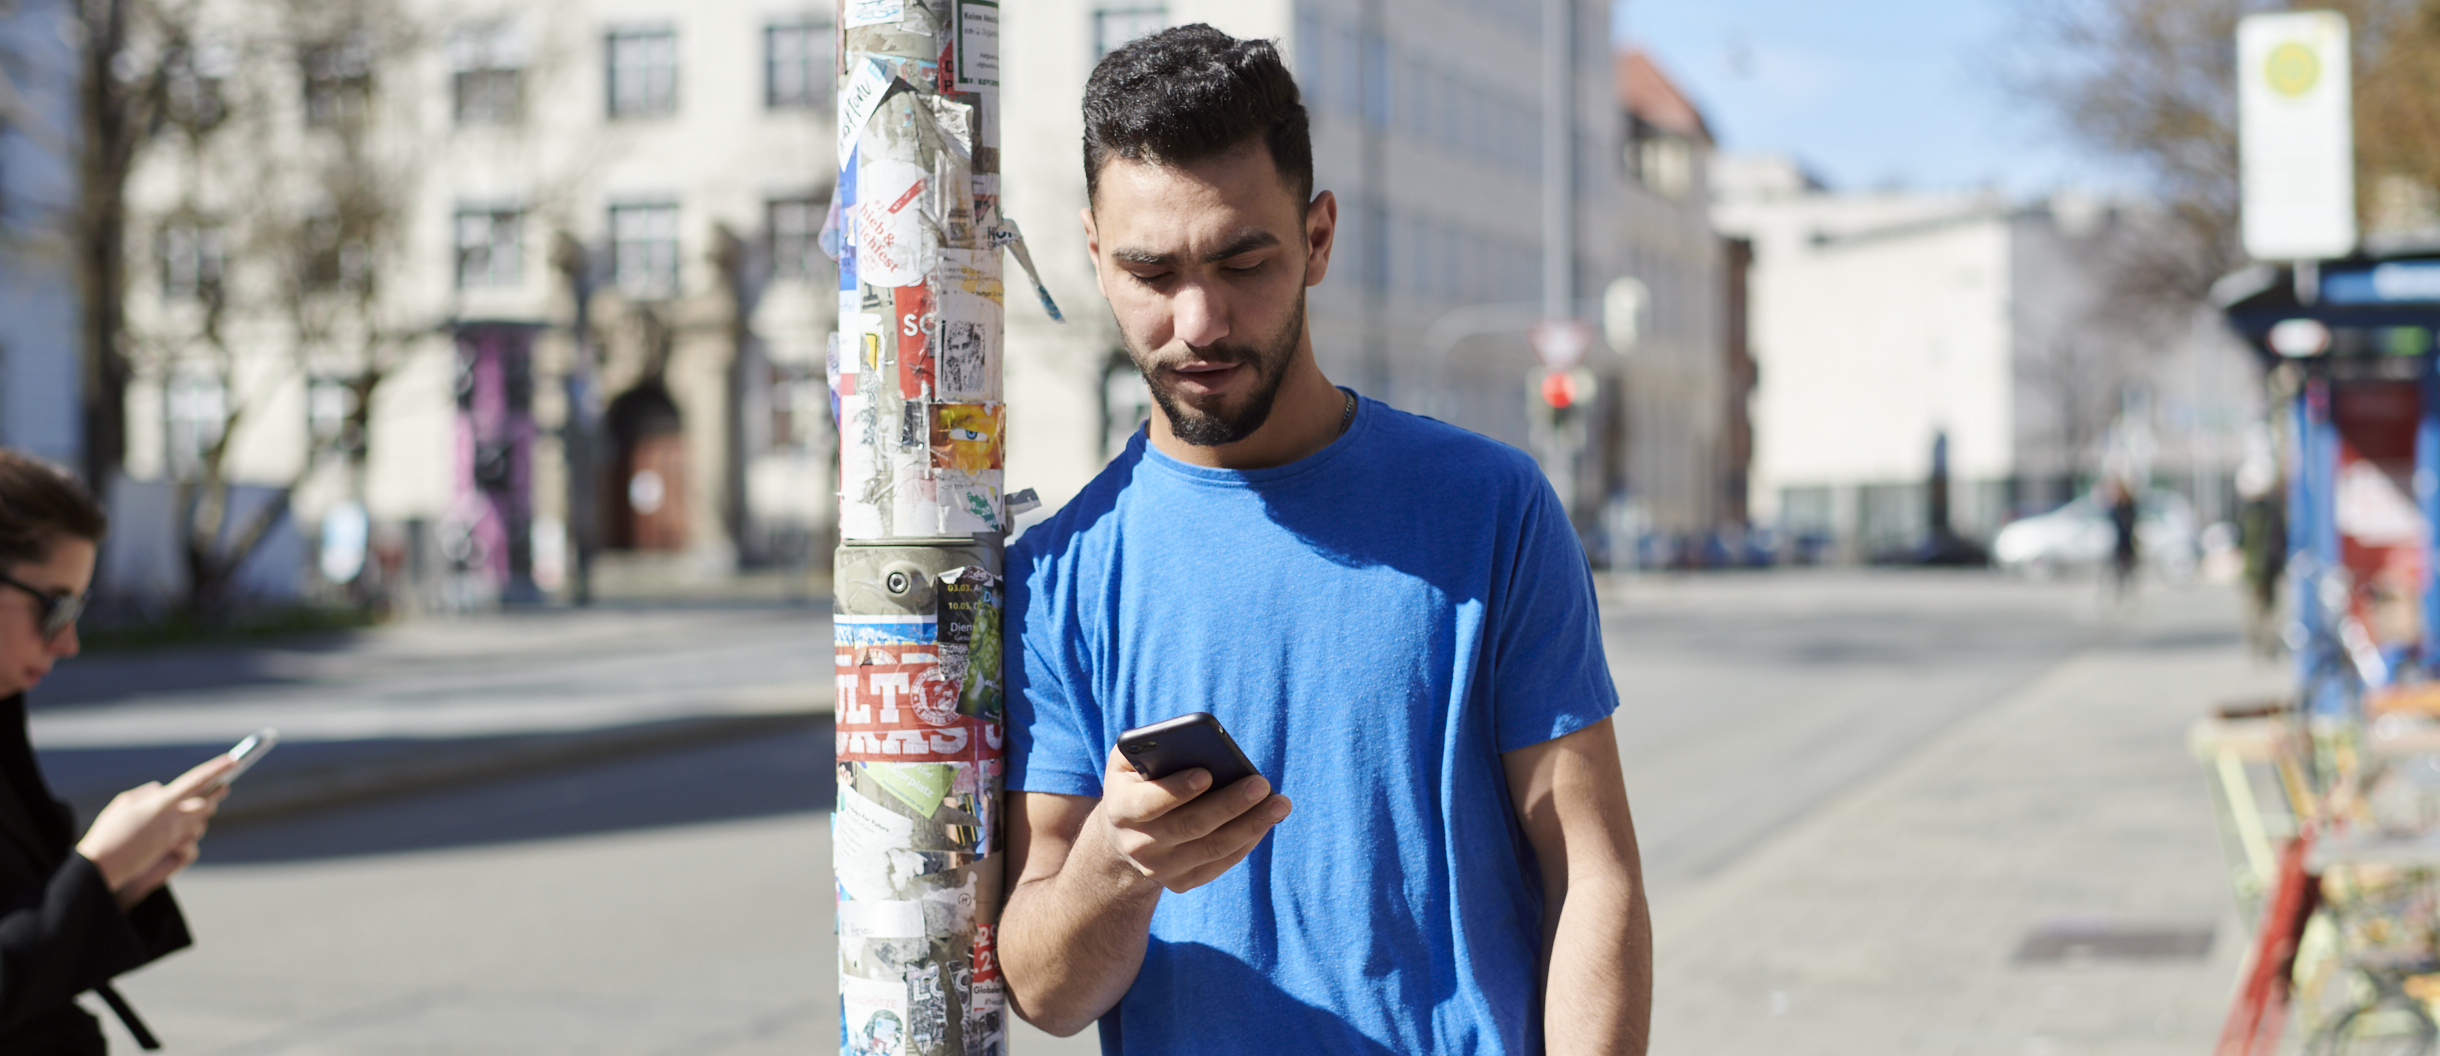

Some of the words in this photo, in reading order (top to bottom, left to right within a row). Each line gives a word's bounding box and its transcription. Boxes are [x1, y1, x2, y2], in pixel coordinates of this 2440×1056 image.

[884, 232, 895, 249] &
[947, 584, 972, 592] 03.03.
[948, 602, 972, 610] 10.03.
